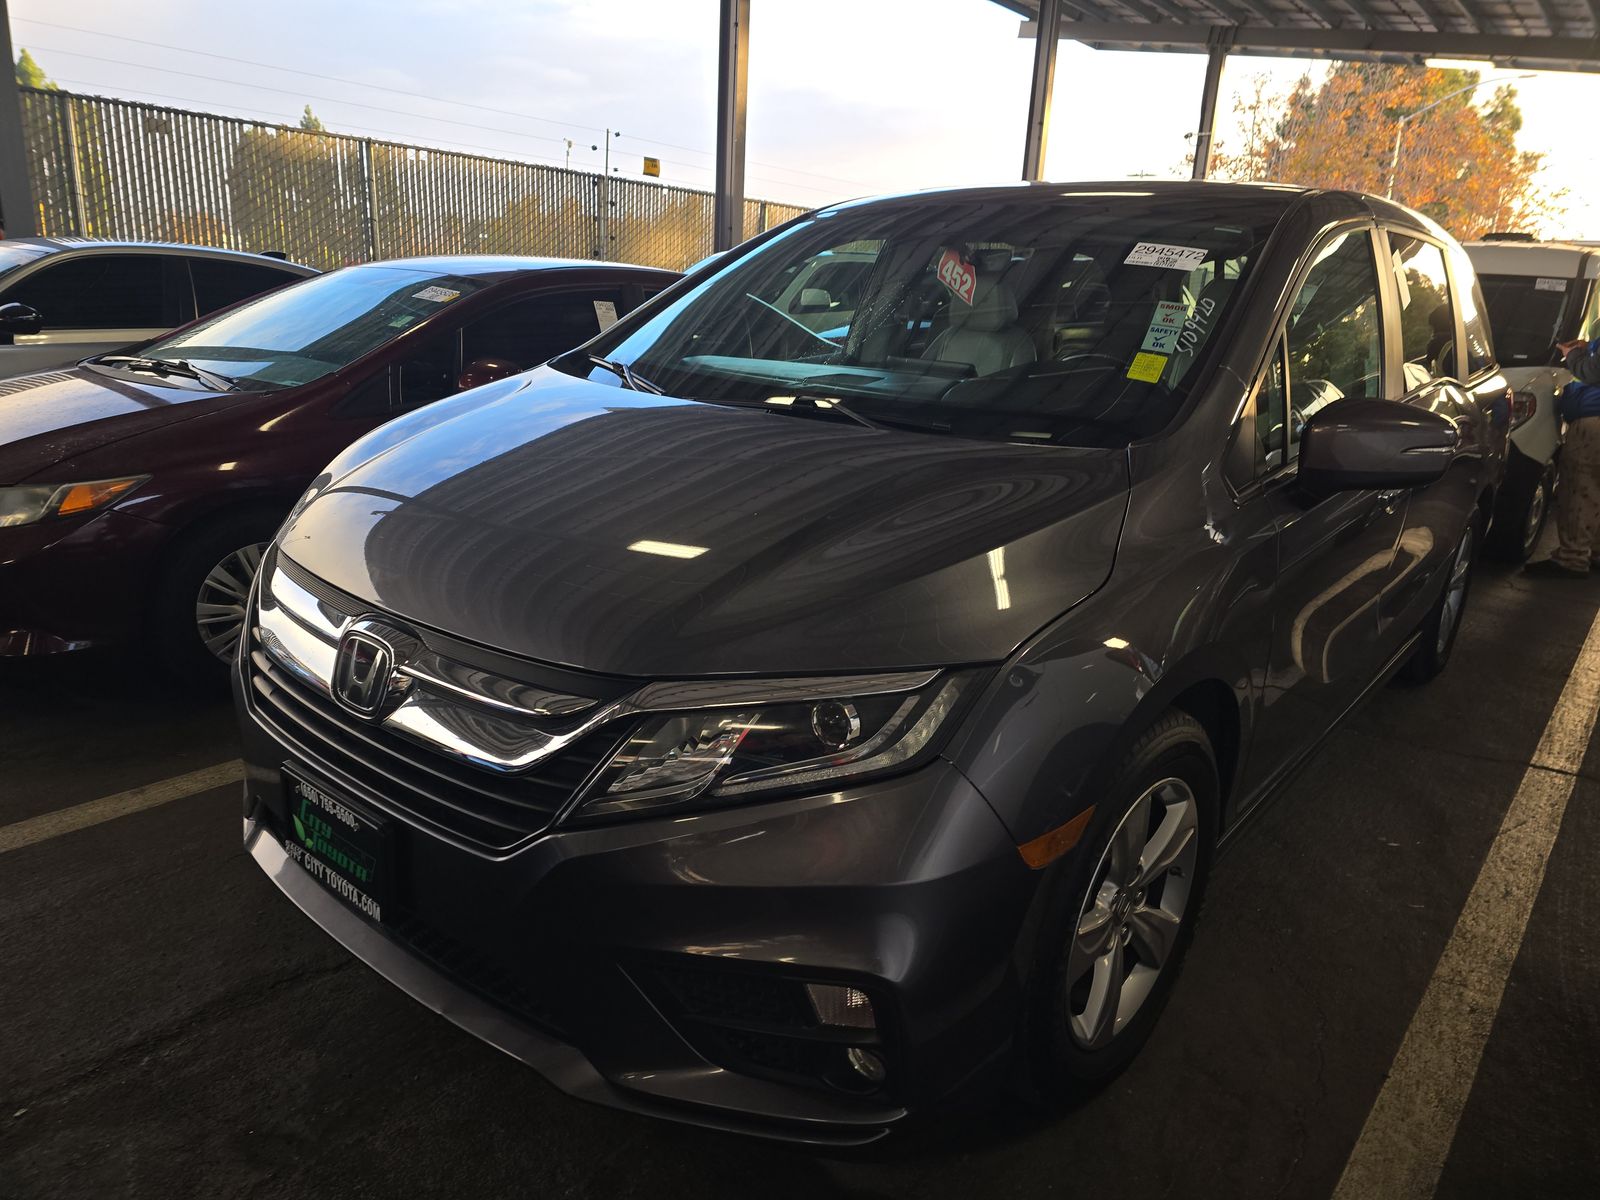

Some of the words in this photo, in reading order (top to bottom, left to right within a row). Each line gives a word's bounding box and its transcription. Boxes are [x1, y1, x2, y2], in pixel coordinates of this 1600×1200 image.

[1134, 245, 1206, 261] 2945472
[941, 259, 972, 300] 452
[1160, 303, 1187, 312] SMOG
[1162, 316, 1175, 324] OK
[1150, 326, 1179, 336] SAFETY
[304, 852, 325, 879] CITY
[325, 866, 381, 922] TOYOTA.COM
